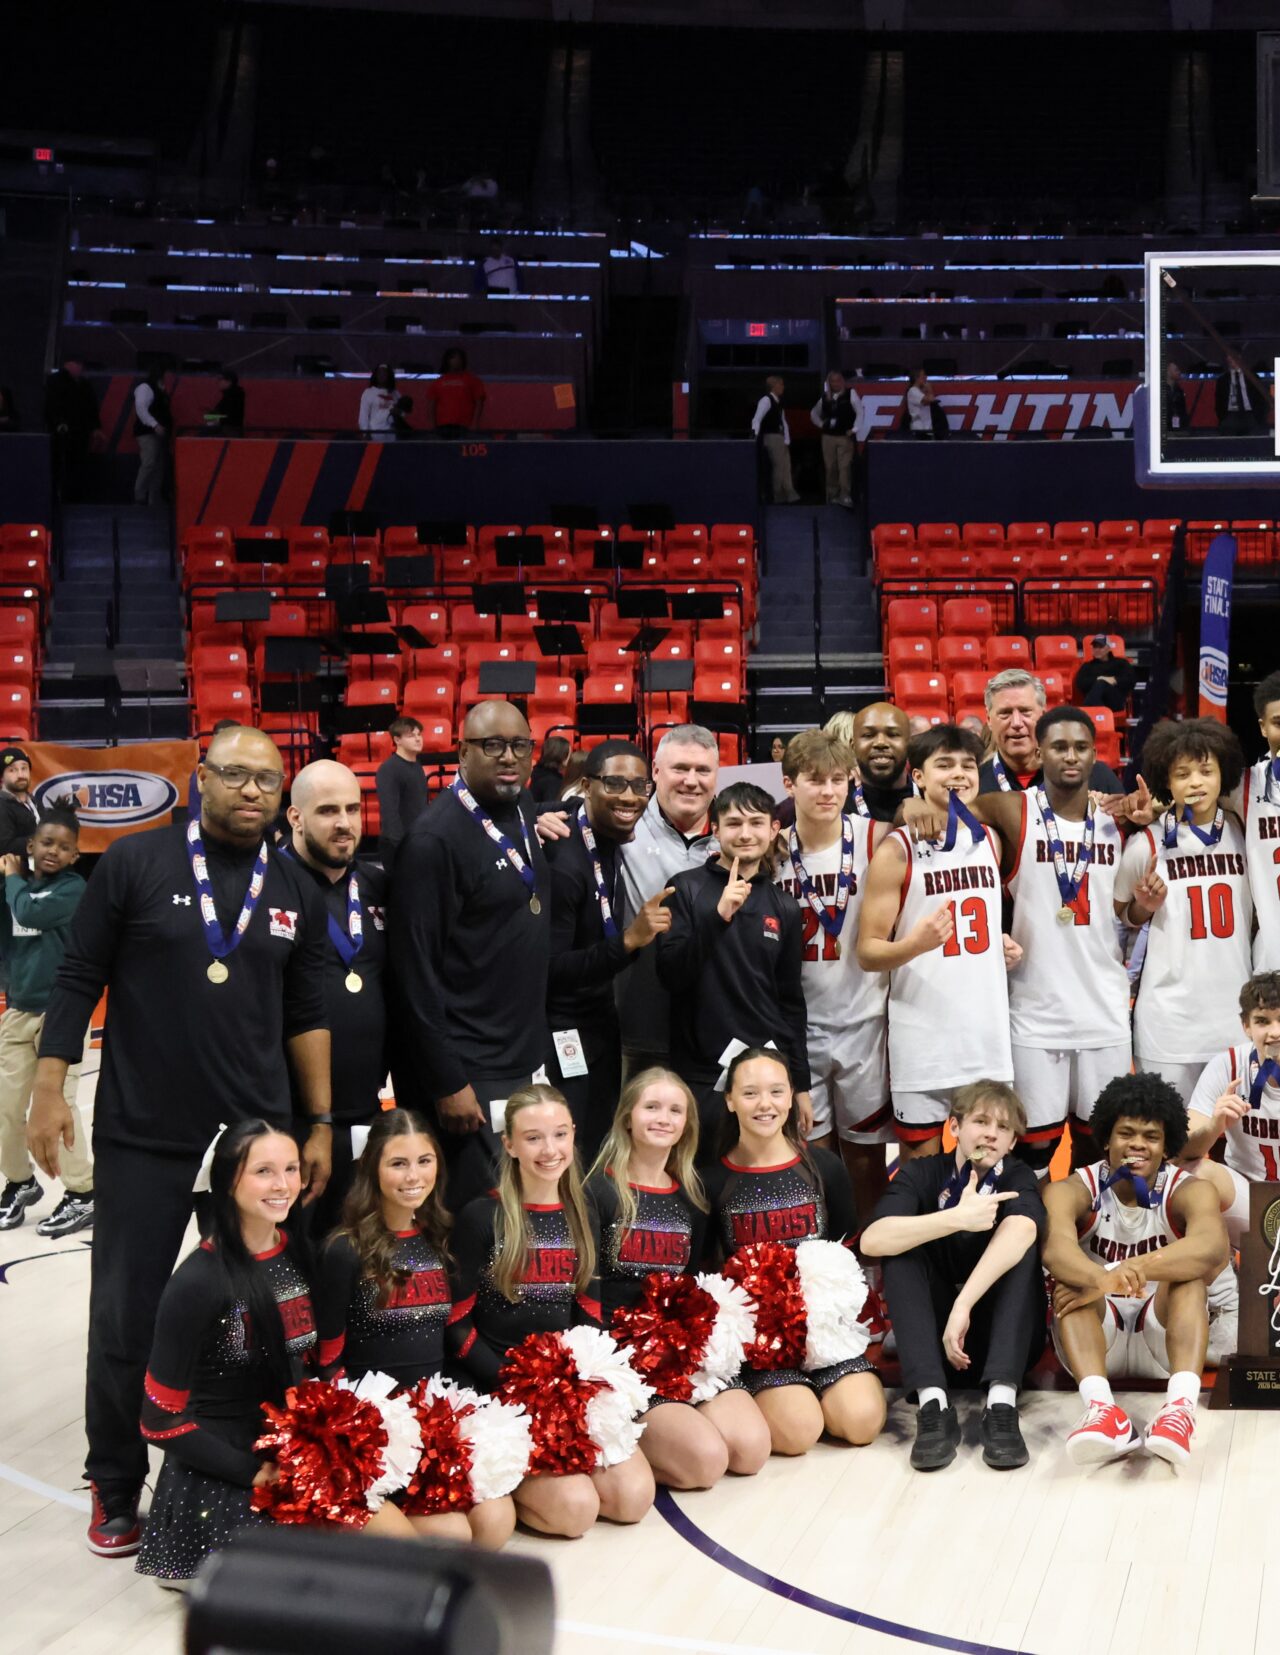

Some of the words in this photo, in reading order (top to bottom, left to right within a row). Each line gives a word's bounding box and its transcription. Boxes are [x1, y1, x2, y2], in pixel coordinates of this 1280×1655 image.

[461, 443, 488, 457] 105
[923, 865, 996, 896] REDHAWKS
[1166, 853, 1244, 881] REDHAWKS
[1187, 882, 1235, 940] 10
[943, 896, 990, 958] 13
[735, 1205, 816, 1243] MARIST
[1246, 1371, 1276, 1381] STATE
